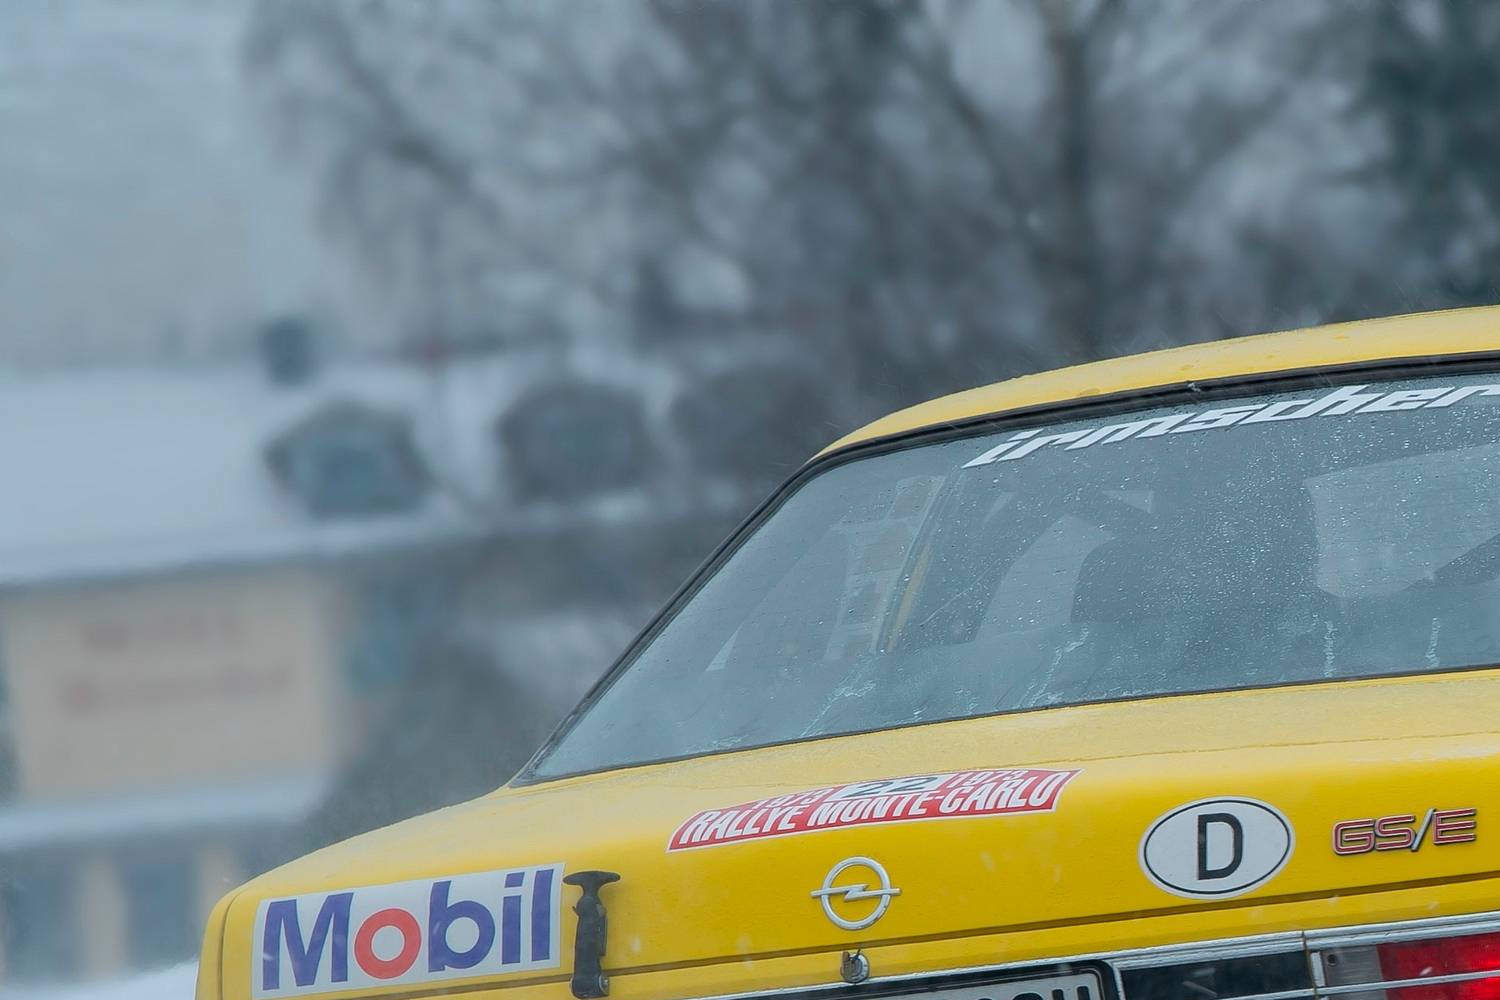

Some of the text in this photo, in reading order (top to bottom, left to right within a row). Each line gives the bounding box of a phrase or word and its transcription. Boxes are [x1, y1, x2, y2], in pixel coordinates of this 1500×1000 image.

[679, 771, 1070, 845] RALLYE MONTE-CARLO
[840, 776, 939, 798] 22
[946, 769, 1030, 789] 1973
[1196, 812, 1244, 881] D
[1332, 807, 1477, 856] GS/E
[262, 868, 555, 991] Mobil
